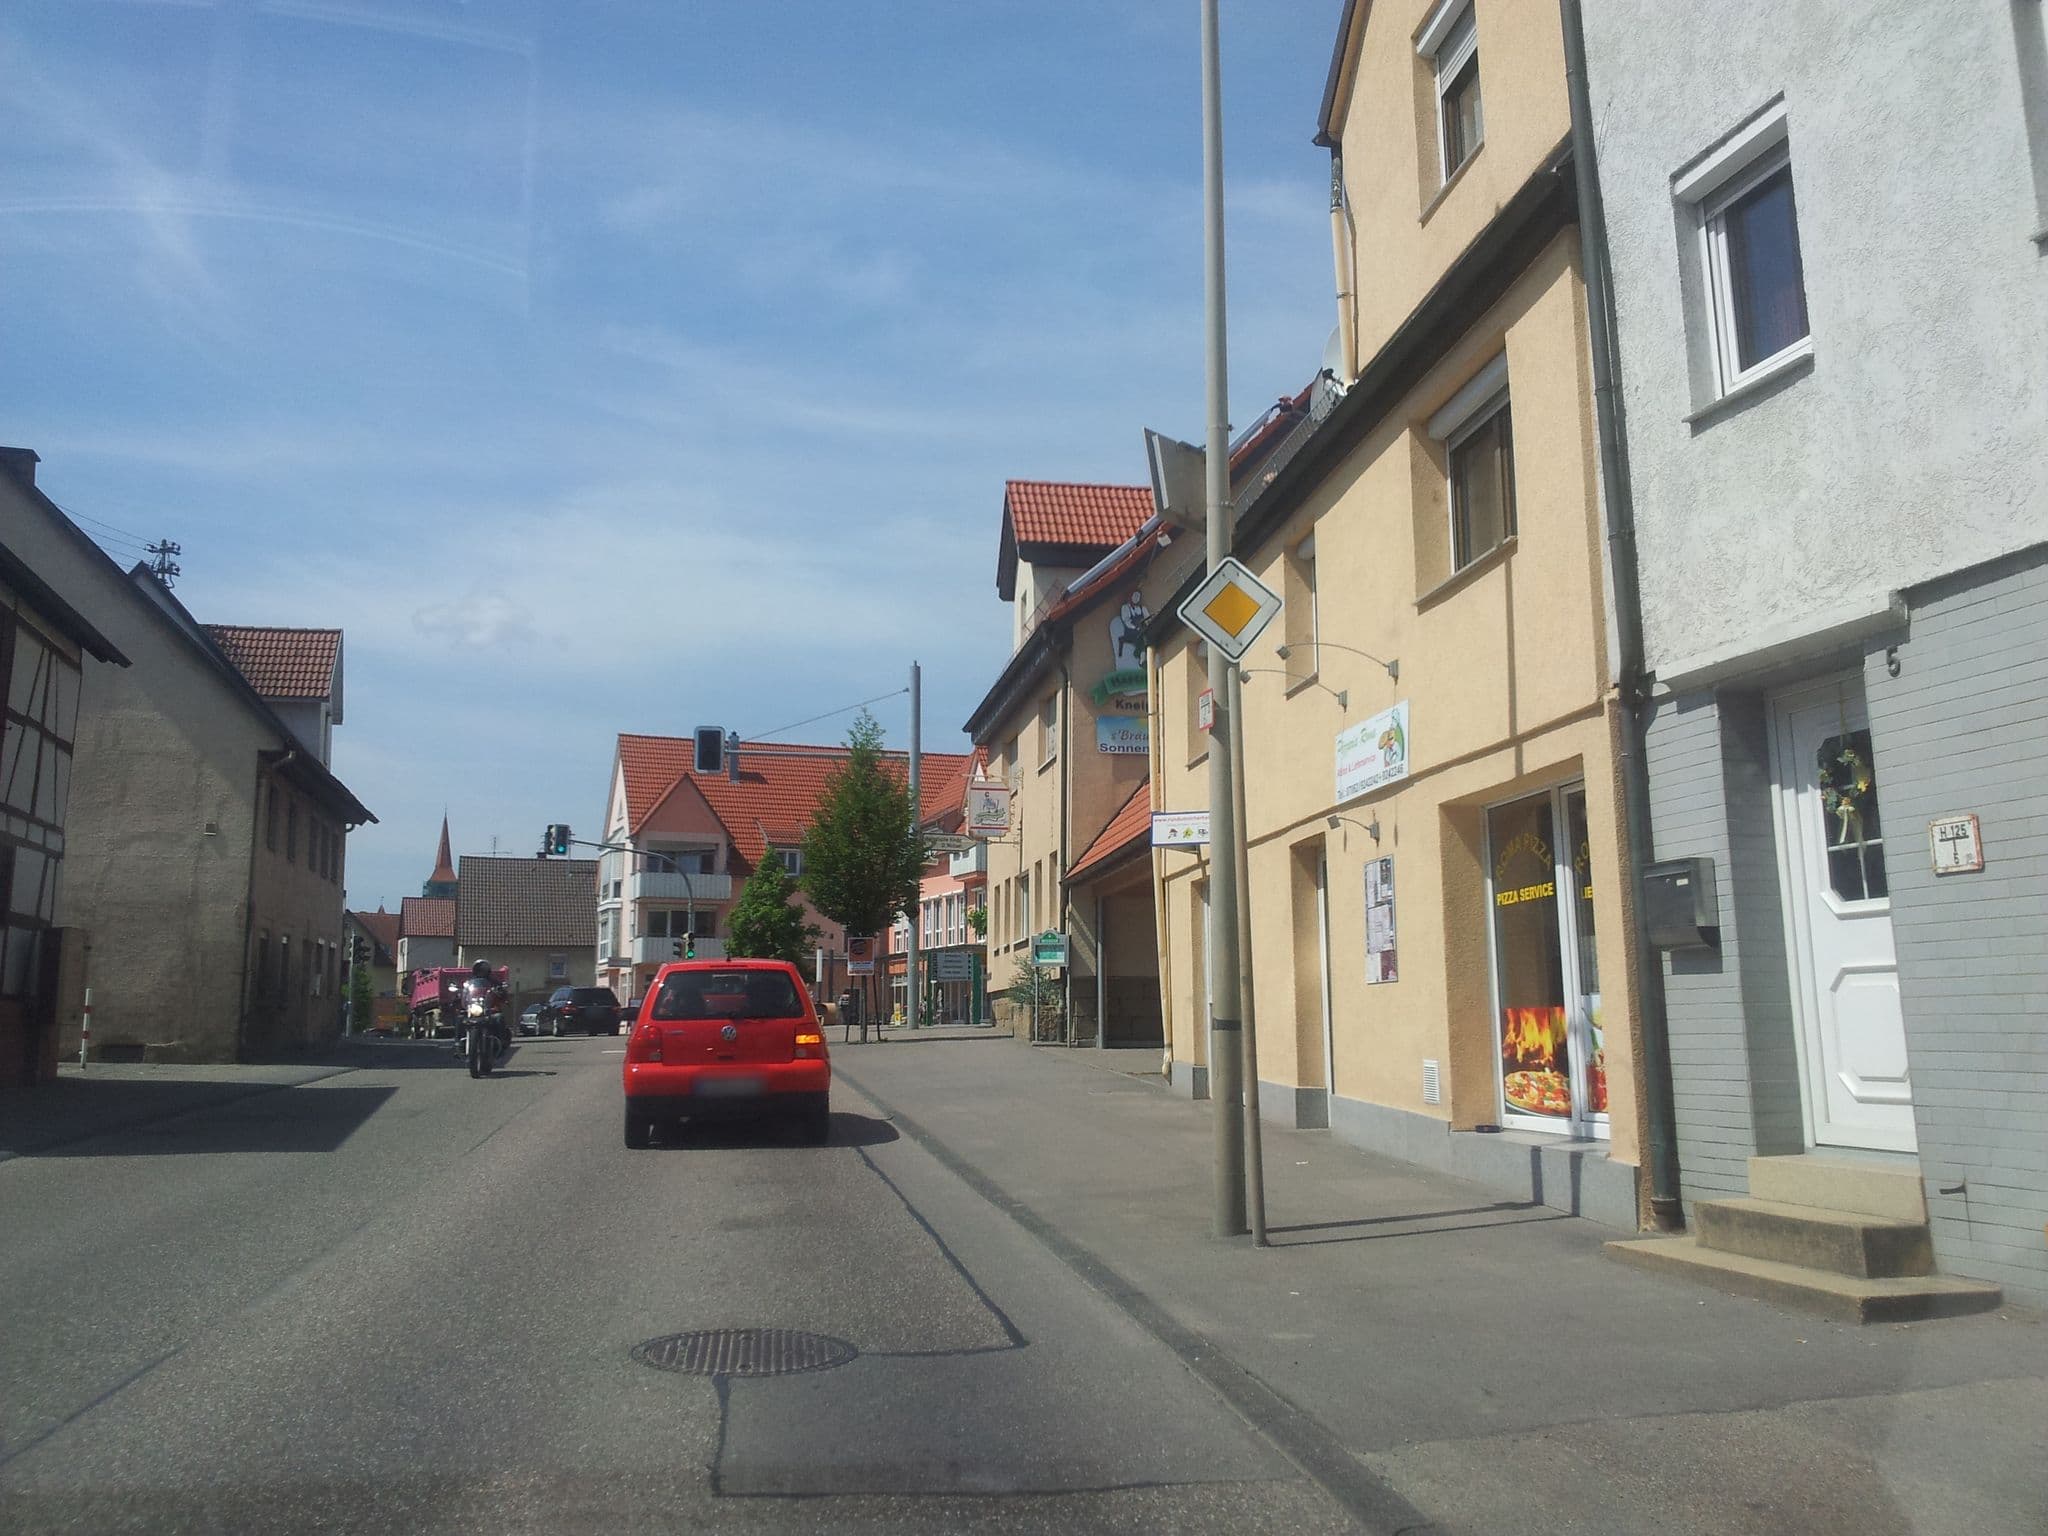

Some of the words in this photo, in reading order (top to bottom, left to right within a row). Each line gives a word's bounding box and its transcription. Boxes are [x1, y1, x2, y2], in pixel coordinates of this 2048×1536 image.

[1950, 824, 1967, 836] 125
[1497, 890, 1518, 906] PIZZA
[1519, 882, 1554, 901] SERVICE
